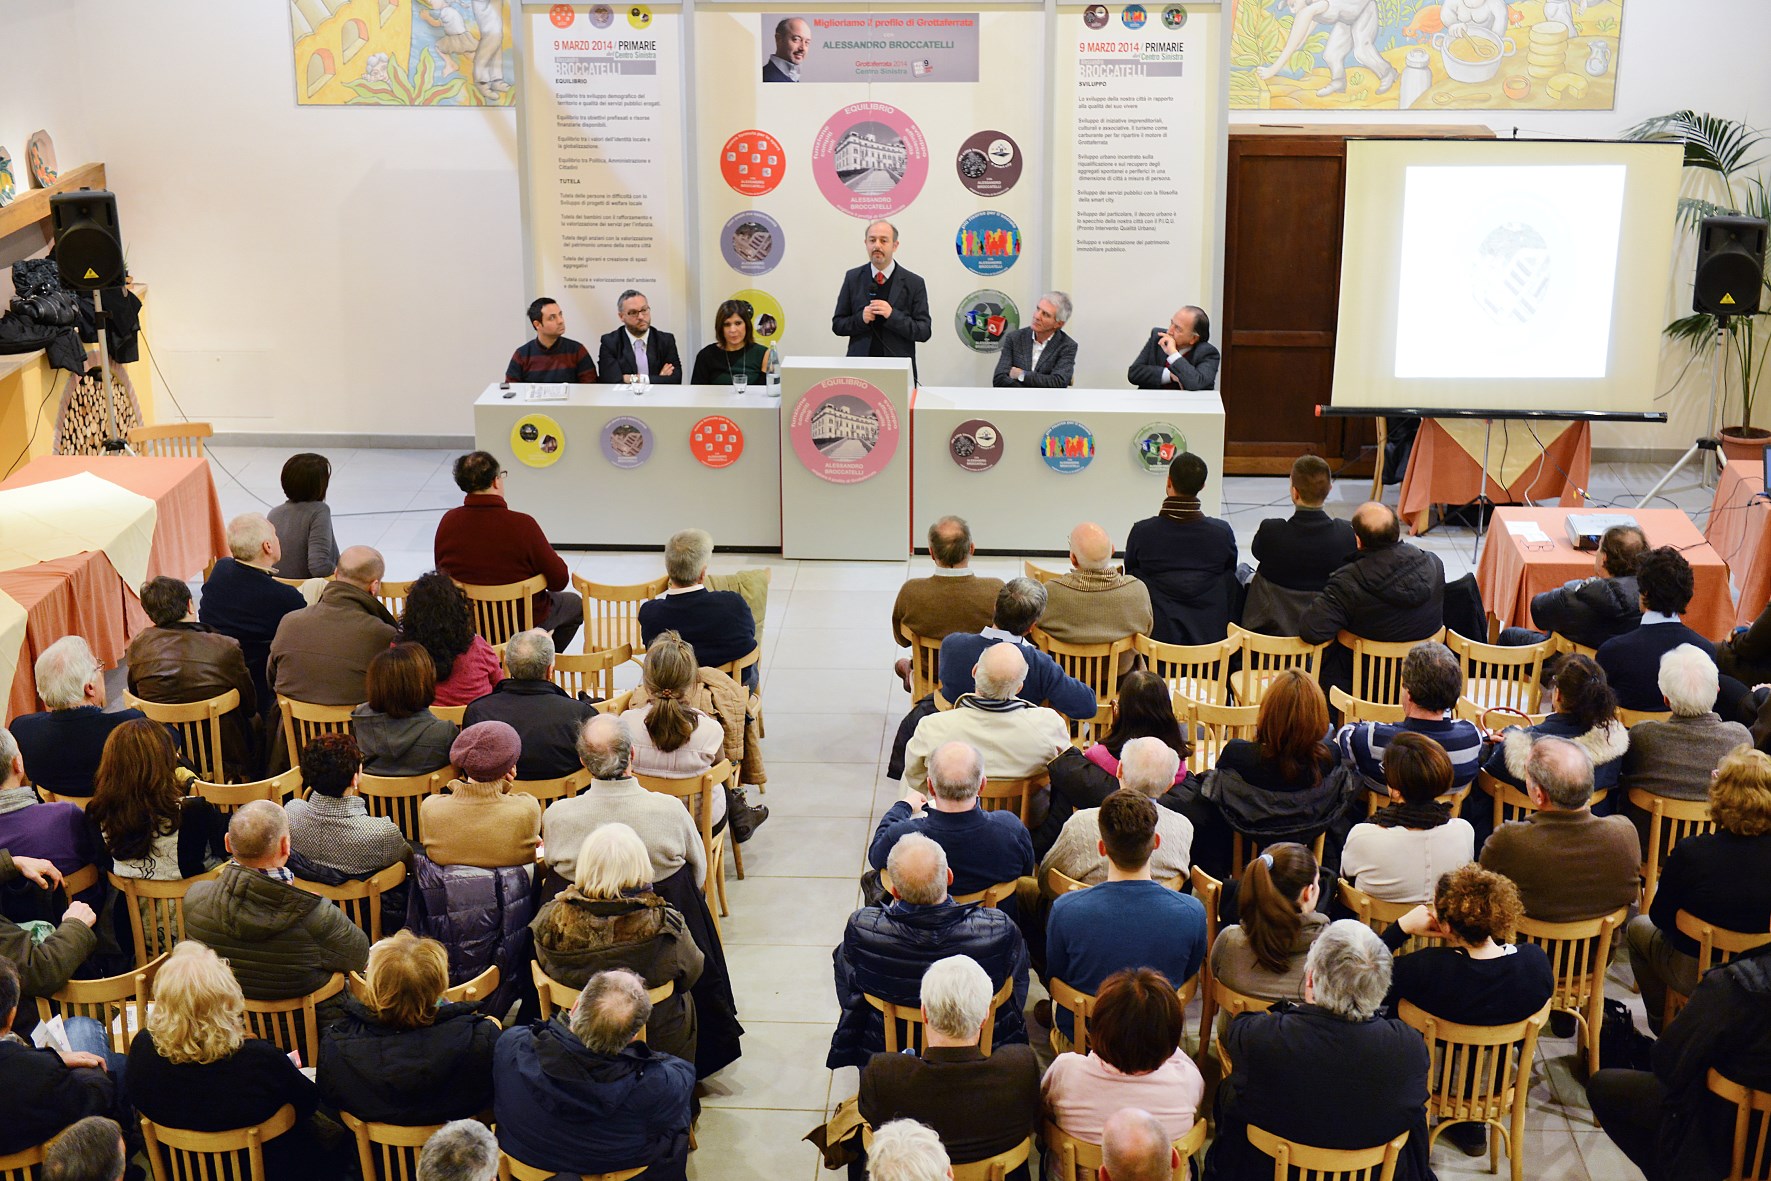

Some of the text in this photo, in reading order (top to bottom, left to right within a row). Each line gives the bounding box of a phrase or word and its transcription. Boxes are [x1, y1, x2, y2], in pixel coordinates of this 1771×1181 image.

[814, 18, 865, 28] Miglioriamo
[876, 19, 904, 28] profilo
[554, 41, 656, 50] 9 MARZO 2014 PRIMARIE
[1079, 42, 1184, 52] 9 MARZO 2014 PRIMARIE
[556, 63, 620, 75] BROCCATELLI
[1080, 65, 1146, 77] BROCCATELLI
[844, 104, 894, 114] EQUILIBRIO
[814, 126, 829, 159] funzione
[911, 125, 927, 157] sviluppo
[821, 379, 868, 389] EQUILIBRIO
[791, 398, 807, 427] funzione
[884, 400, 898, 429] sviluppo
